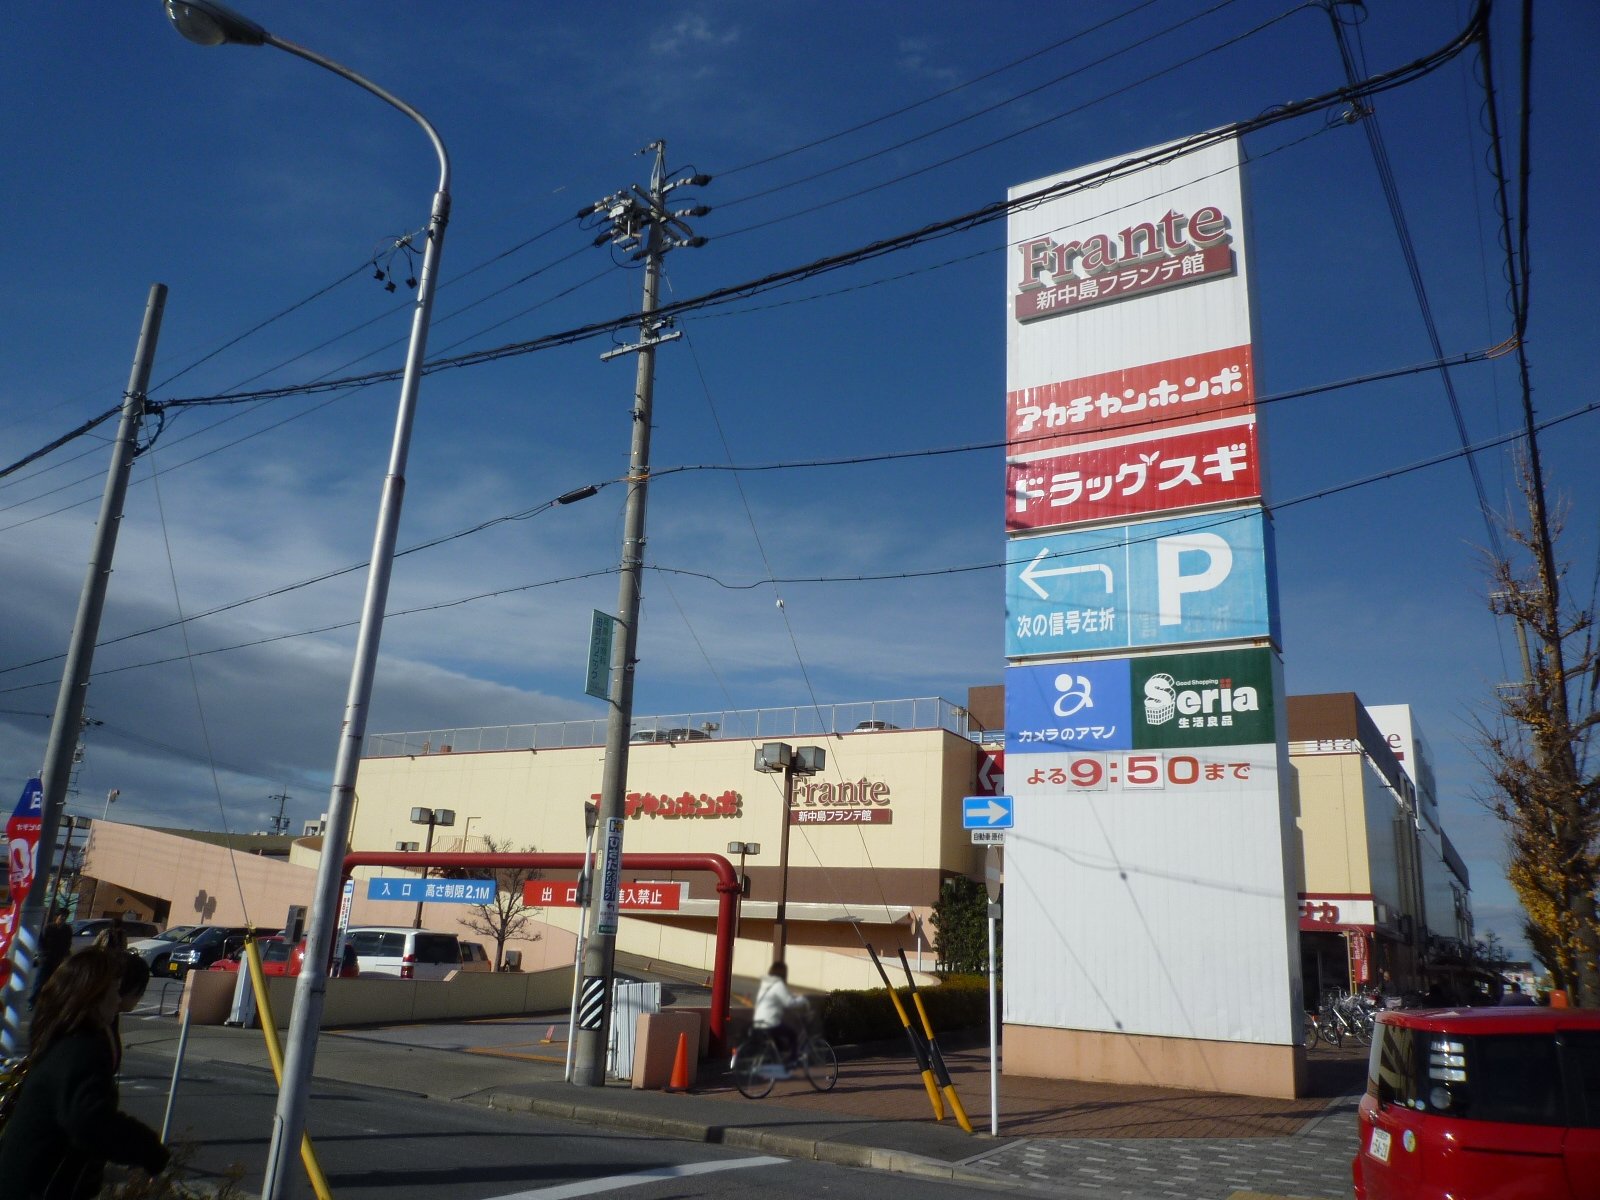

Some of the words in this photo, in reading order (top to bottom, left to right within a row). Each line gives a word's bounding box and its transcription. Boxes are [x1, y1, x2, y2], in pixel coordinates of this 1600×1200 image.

[1018, 206, 1227, 290] Frante
[1036, 253, 1205, 310] 新中島フランテ館
[1016, 365, 1243, 432] アカチャンホンポ
[1015, 443, 1247, 513] ドラッグスギ
[1157, 532, 1233, 626] P
[1016, 606, 1115, 638] 次の信号左折
[1144, 673, 1259, 716] Seria
[1018, 725, 1116, 744] カメラのアマノ
[1178, 715, 1233, 729] 生活良品
[791, 776, 890, 804] Frante
[798, 809, 872, 822] 新中島フランテ館
